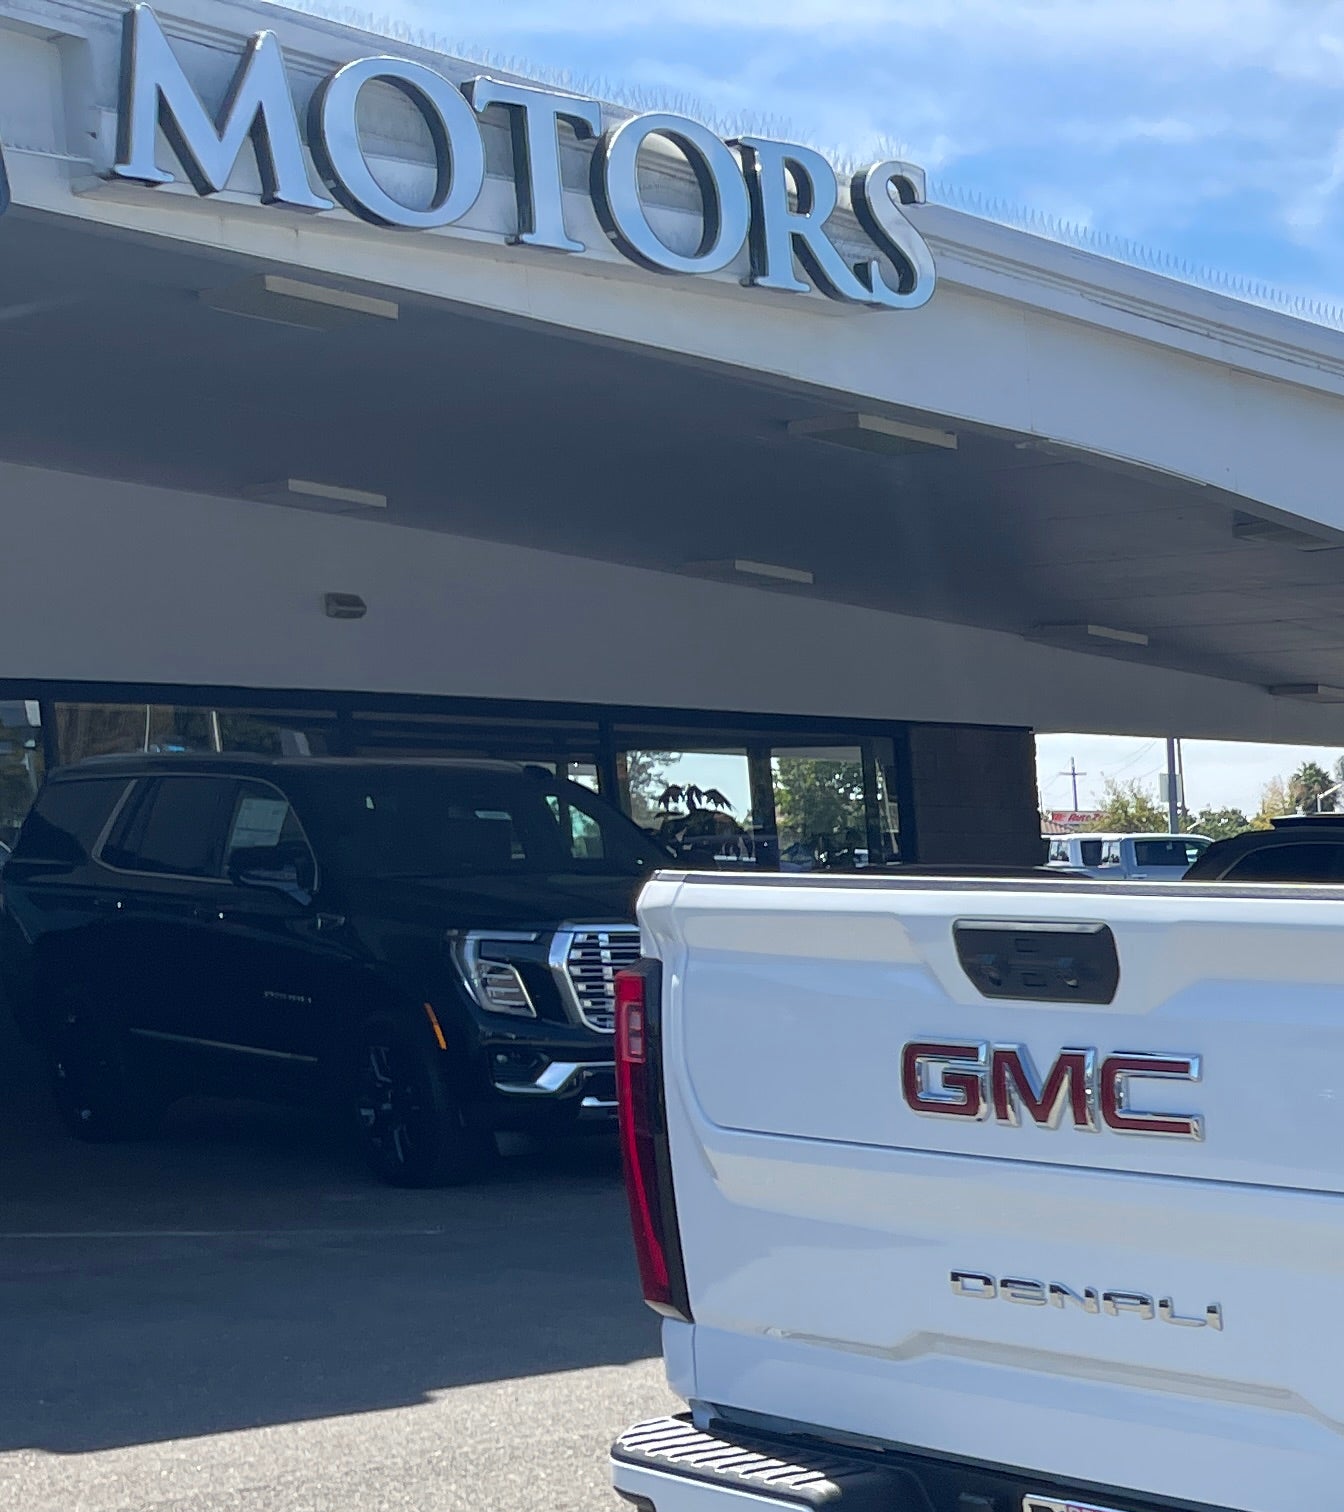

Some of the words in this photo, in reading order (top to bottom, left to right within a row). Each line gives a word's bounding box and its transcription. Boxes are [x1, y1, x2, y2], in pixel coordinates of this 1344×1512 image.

[113, 2, 936, 310] MOTORS
[902, 1035, 1204, 1141] GMC
[948, 1268, 1224, 1331] DENALI
